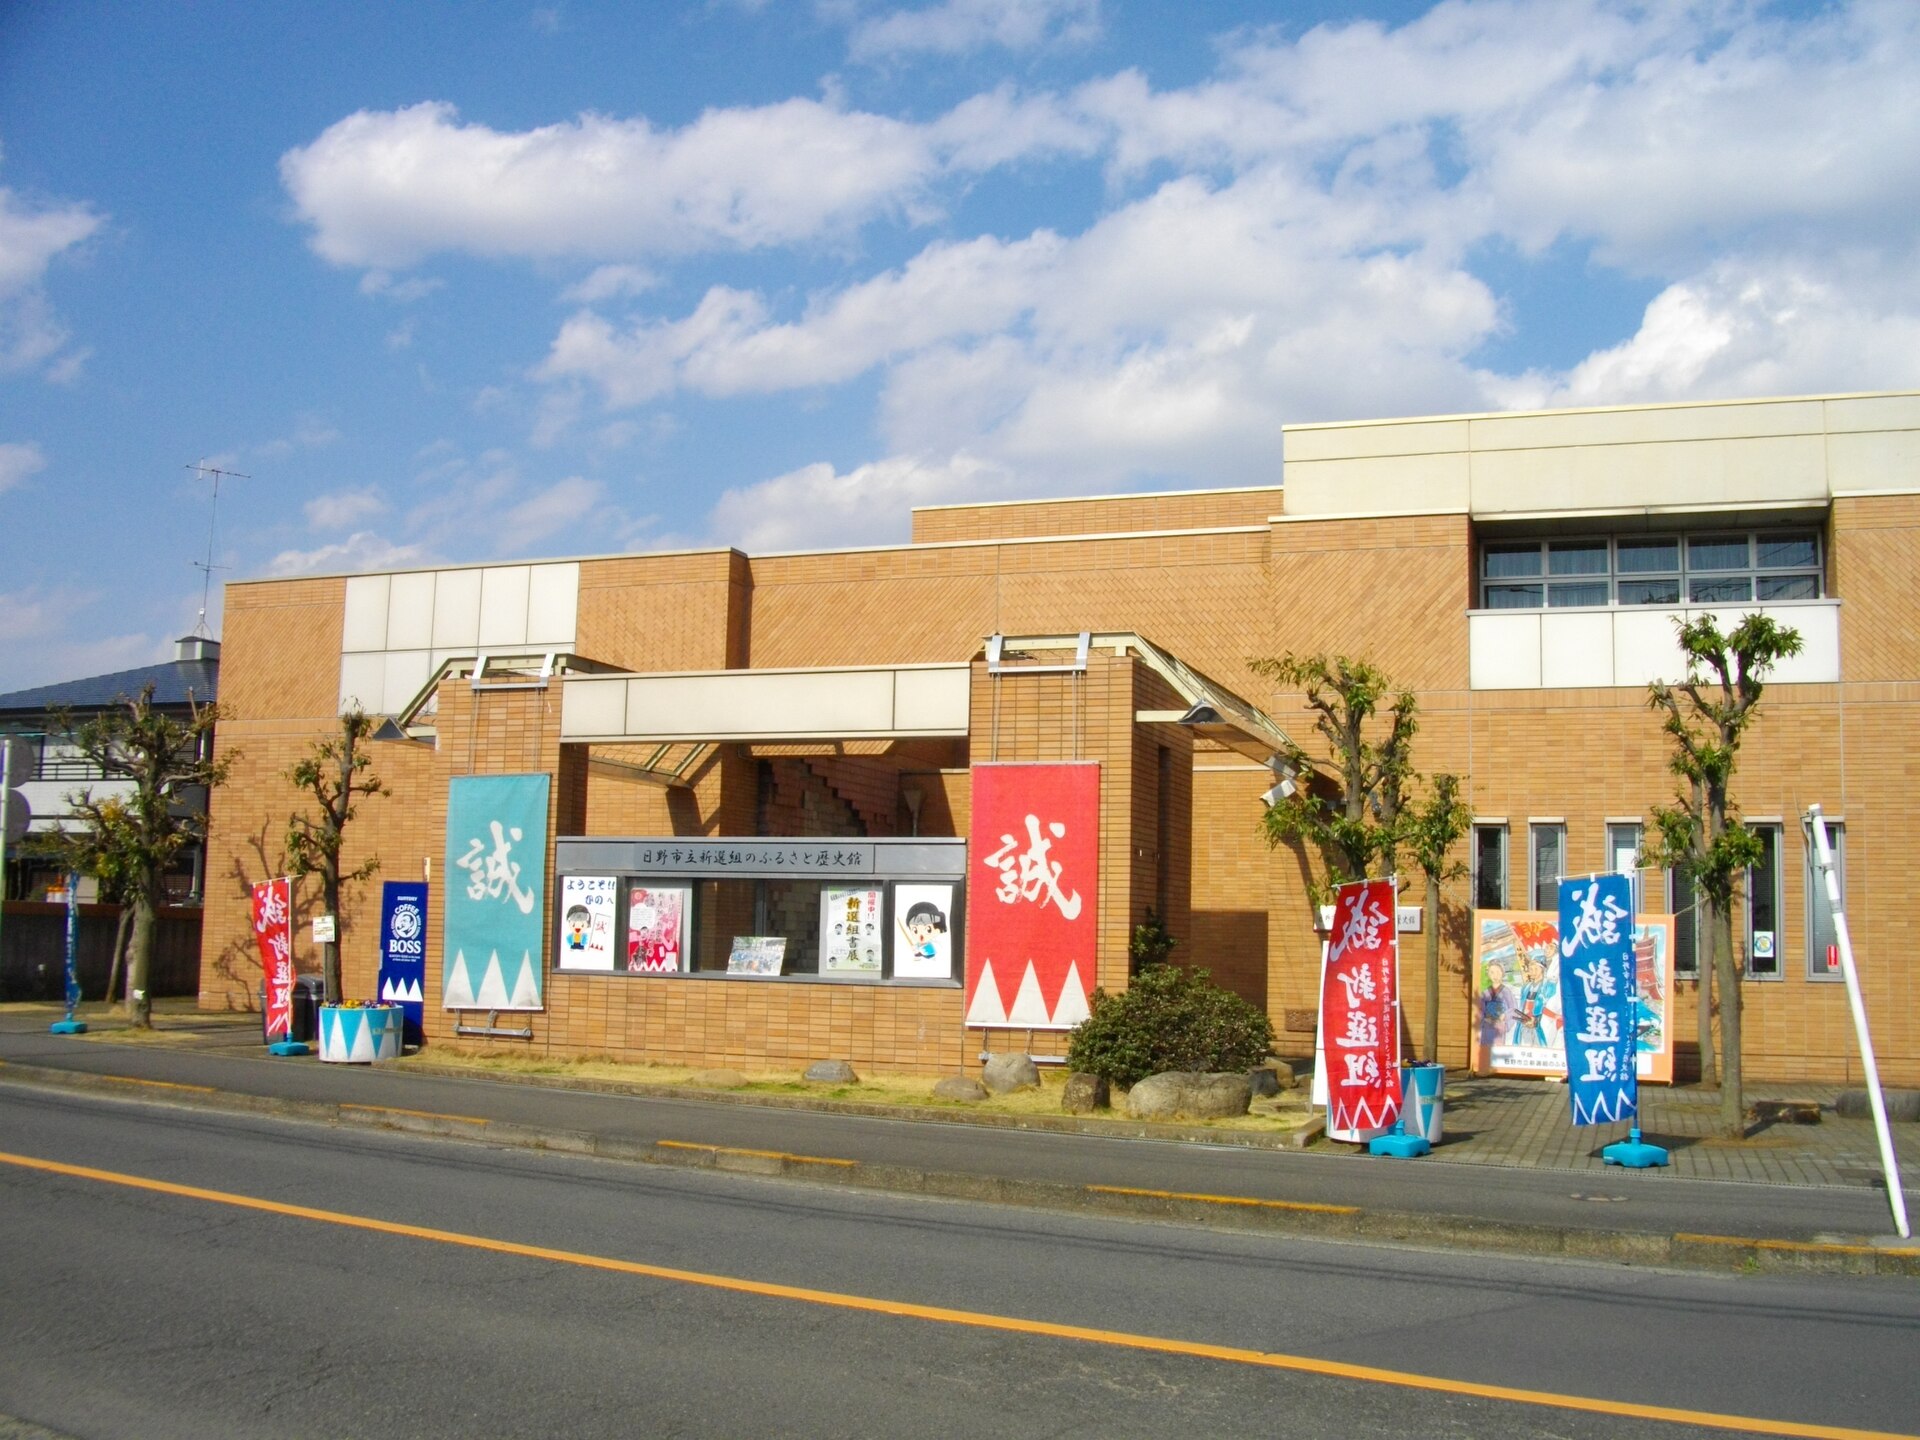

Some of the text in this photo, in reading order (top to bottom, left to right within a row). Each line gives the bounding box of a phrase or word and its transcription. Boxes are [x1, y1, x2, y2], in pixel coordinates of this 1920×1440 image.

[456, 820, 535, 915] 誠
[643, 849, 863, 867] 日野市立新選組のふるさと歴史館
[983, 814, 1082, 921] 誠
[394, 903, 419, 915] COFFEE
[846, 896, 862, 961] 新選組書展
[389, 939, 422, 954] BOSS
